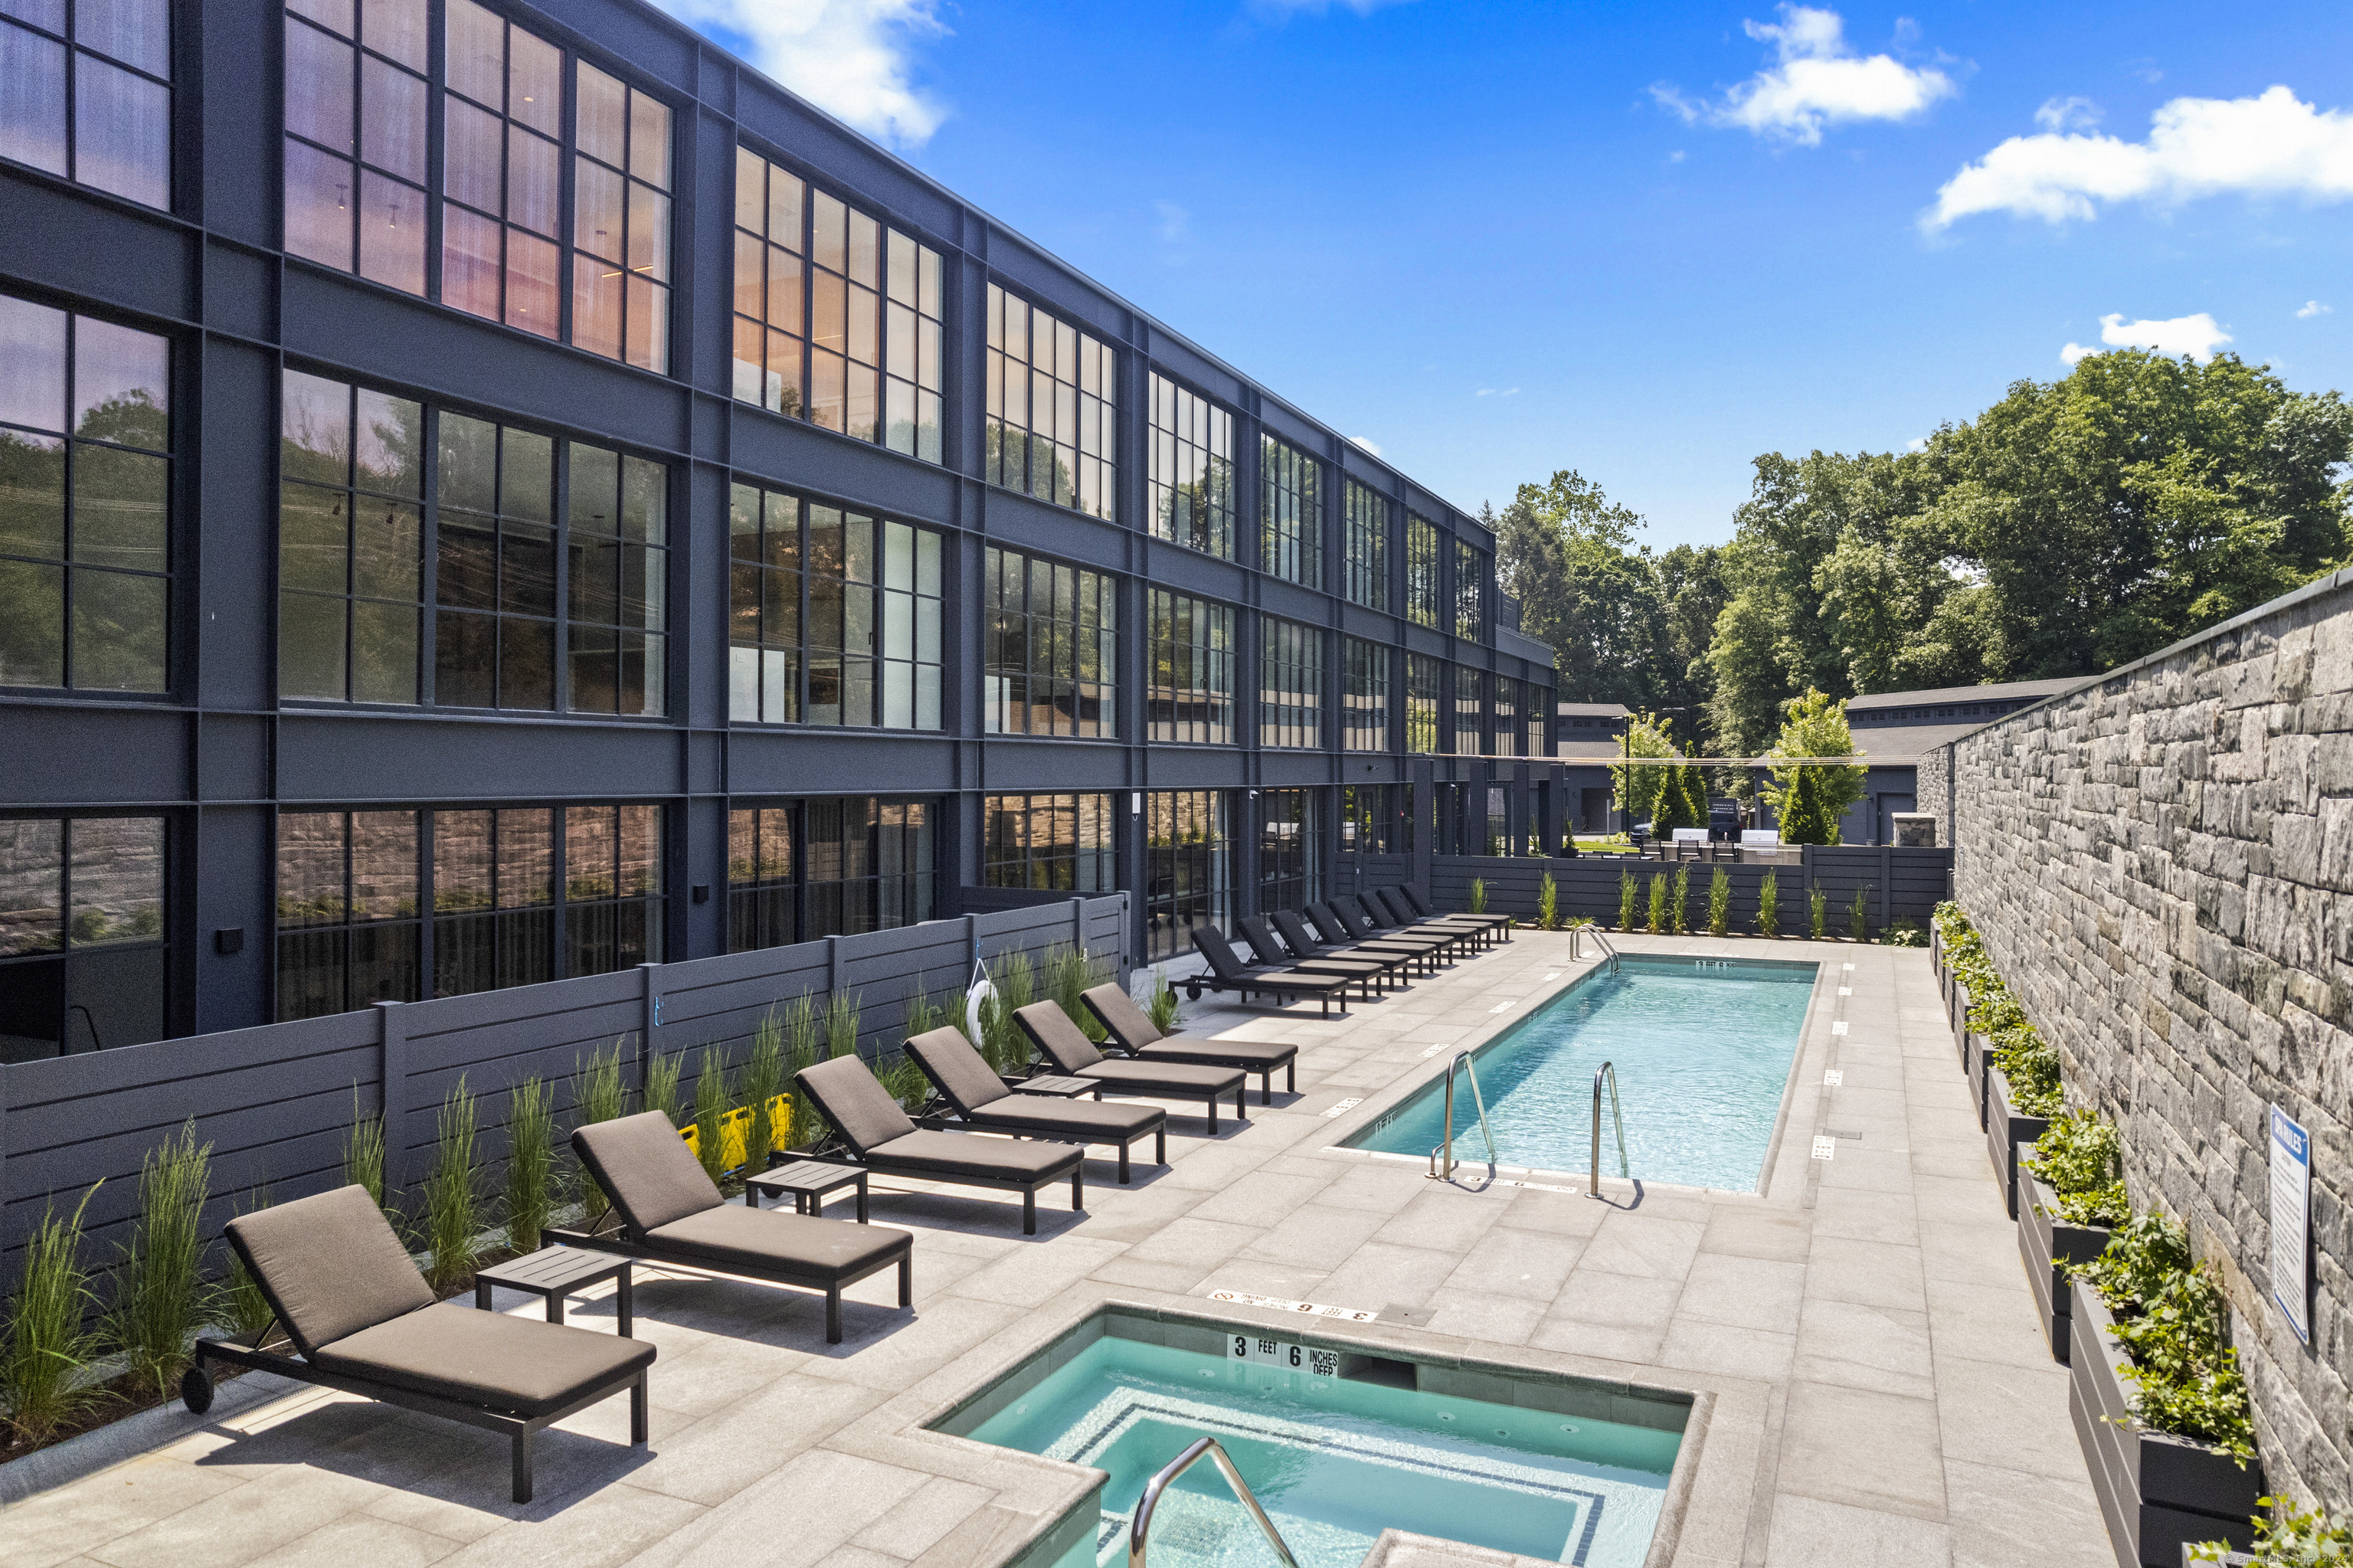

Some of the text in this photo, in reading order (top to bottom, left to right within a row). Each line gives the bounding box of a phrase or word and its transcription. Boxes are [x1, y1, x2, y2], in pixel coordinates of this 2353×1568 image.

[2274, 1115, 2302, 1154] SPA RULES
[1240, 1293, 1268, 1301] DIVING
[1297, 1304, 1369, 1321] 3 FEET 6
[1235, 1336, 1301, 1367] 3 FEET 6
[1310, 1349, 1337, 1367] INCHES
[1313, 1363, 1334, 1377] DEEP
